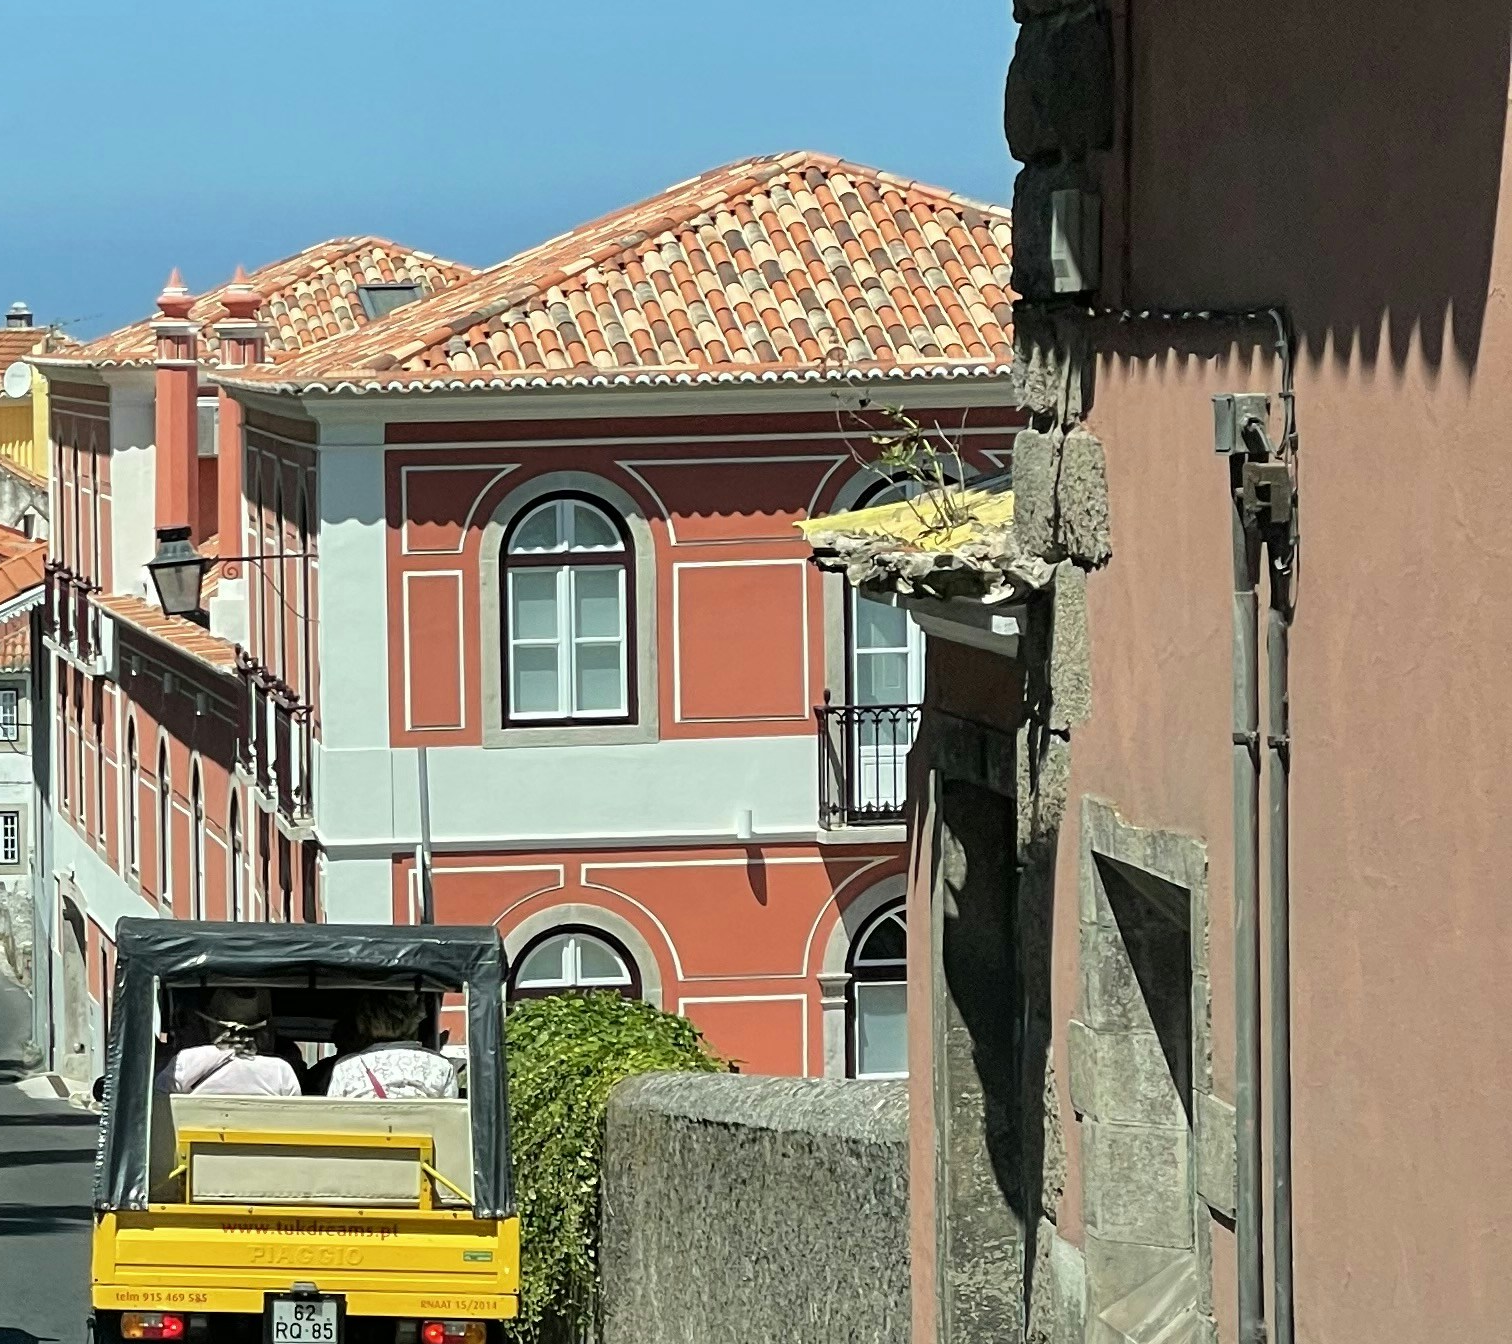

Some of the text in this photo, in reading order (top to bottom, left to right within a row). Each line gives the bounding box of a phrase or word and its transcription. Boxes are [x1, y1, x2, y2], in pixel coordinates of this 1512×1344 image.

[221, 1219, 399, 1241] www.tukdreams.pt
[248, 1244, 364, 1266] PIAGGIO
[142, 1292, 162, 1302] 915
[166, 1292, 185, 1302] 469
[188, 1293, 208, 1304] 585
[294, 1304, 316, 1322] 62
